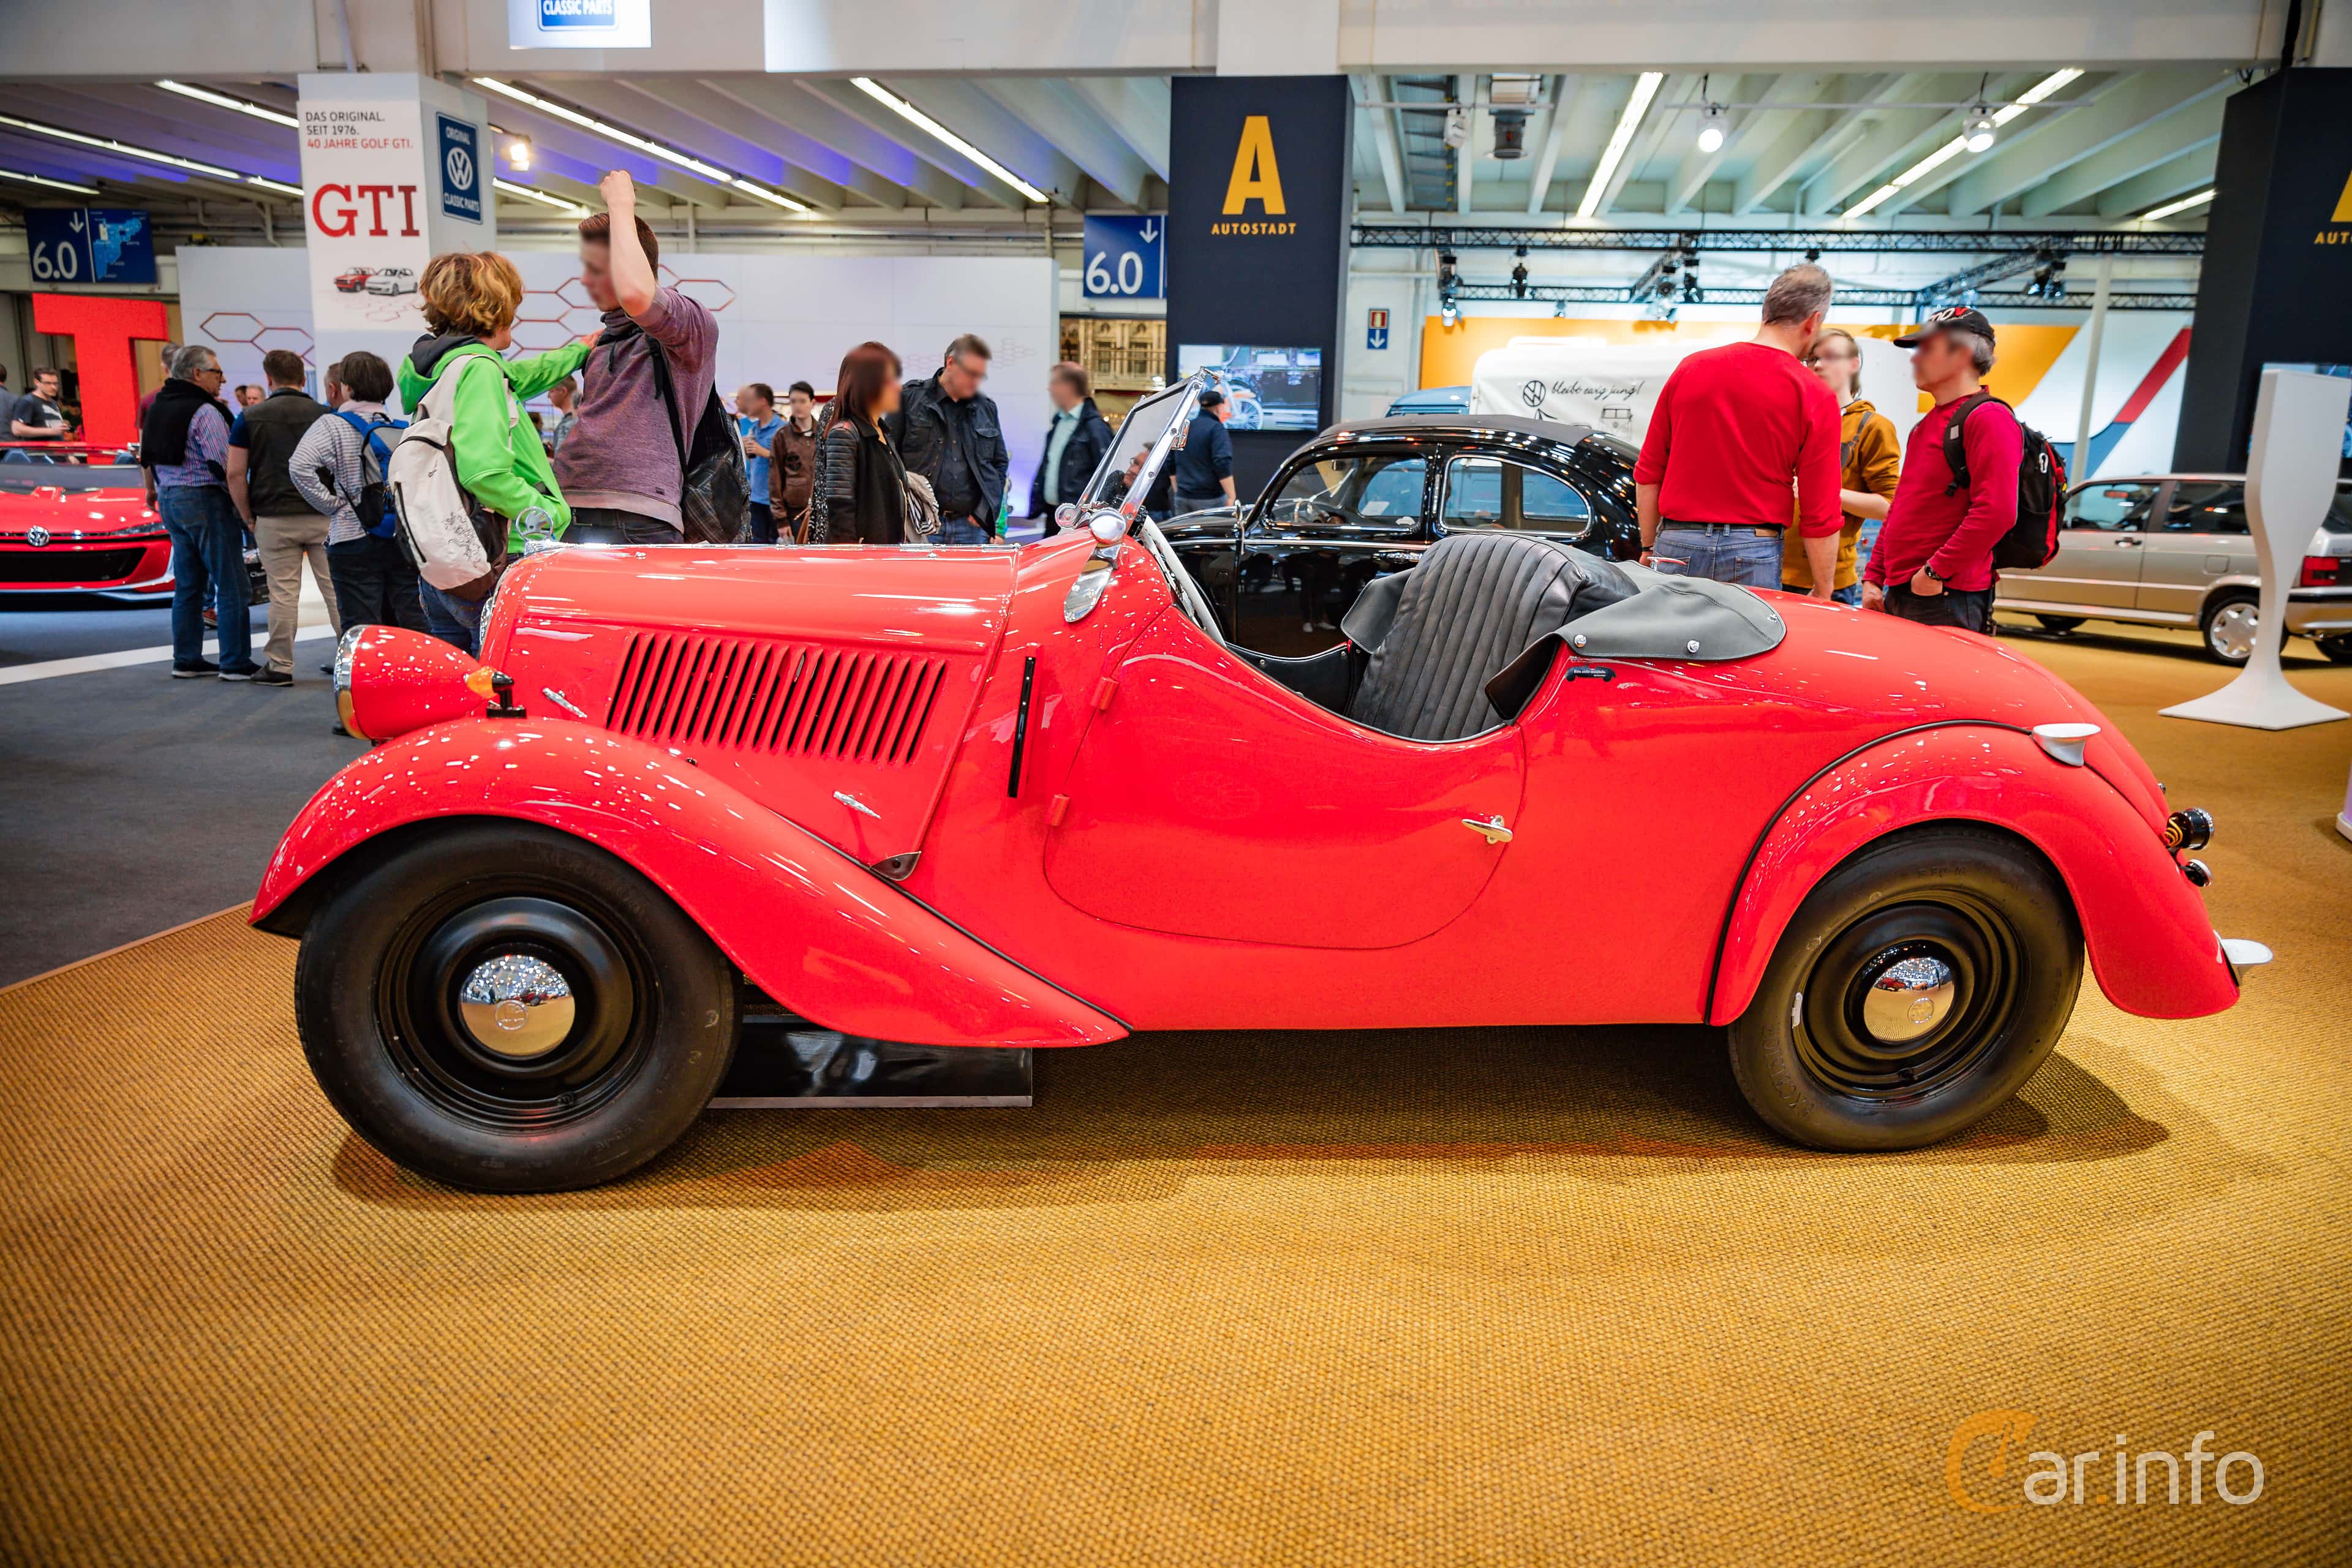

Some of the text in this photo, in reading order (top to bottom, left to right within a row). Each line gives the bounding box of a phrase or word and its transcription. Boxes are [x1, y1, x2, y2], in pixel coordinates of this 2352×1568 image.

[543, 0, 612, 15] CLASSIC PARTS
[306, 111, 385, 122] DAS ORIGINAL.
[306, 125, 360, 135] SEIT 1976.
[445, 126, 471, 145] ORIGINAL
[307, 138, 413, 149] 40 JAHRE GOLF GTI.
[1222, 115, 1286, 215] A
[312, 183, 420, 238] GTI
[443, 192, 480, 213] CLASSIC PARTS
[1210, 222, 1297, 235] AUTOSTADT
[2313, 231, 2352, 244] AUT
[32, 241, 78, 279] 6.0
[1085, 251, 1144, 295] 6.0
